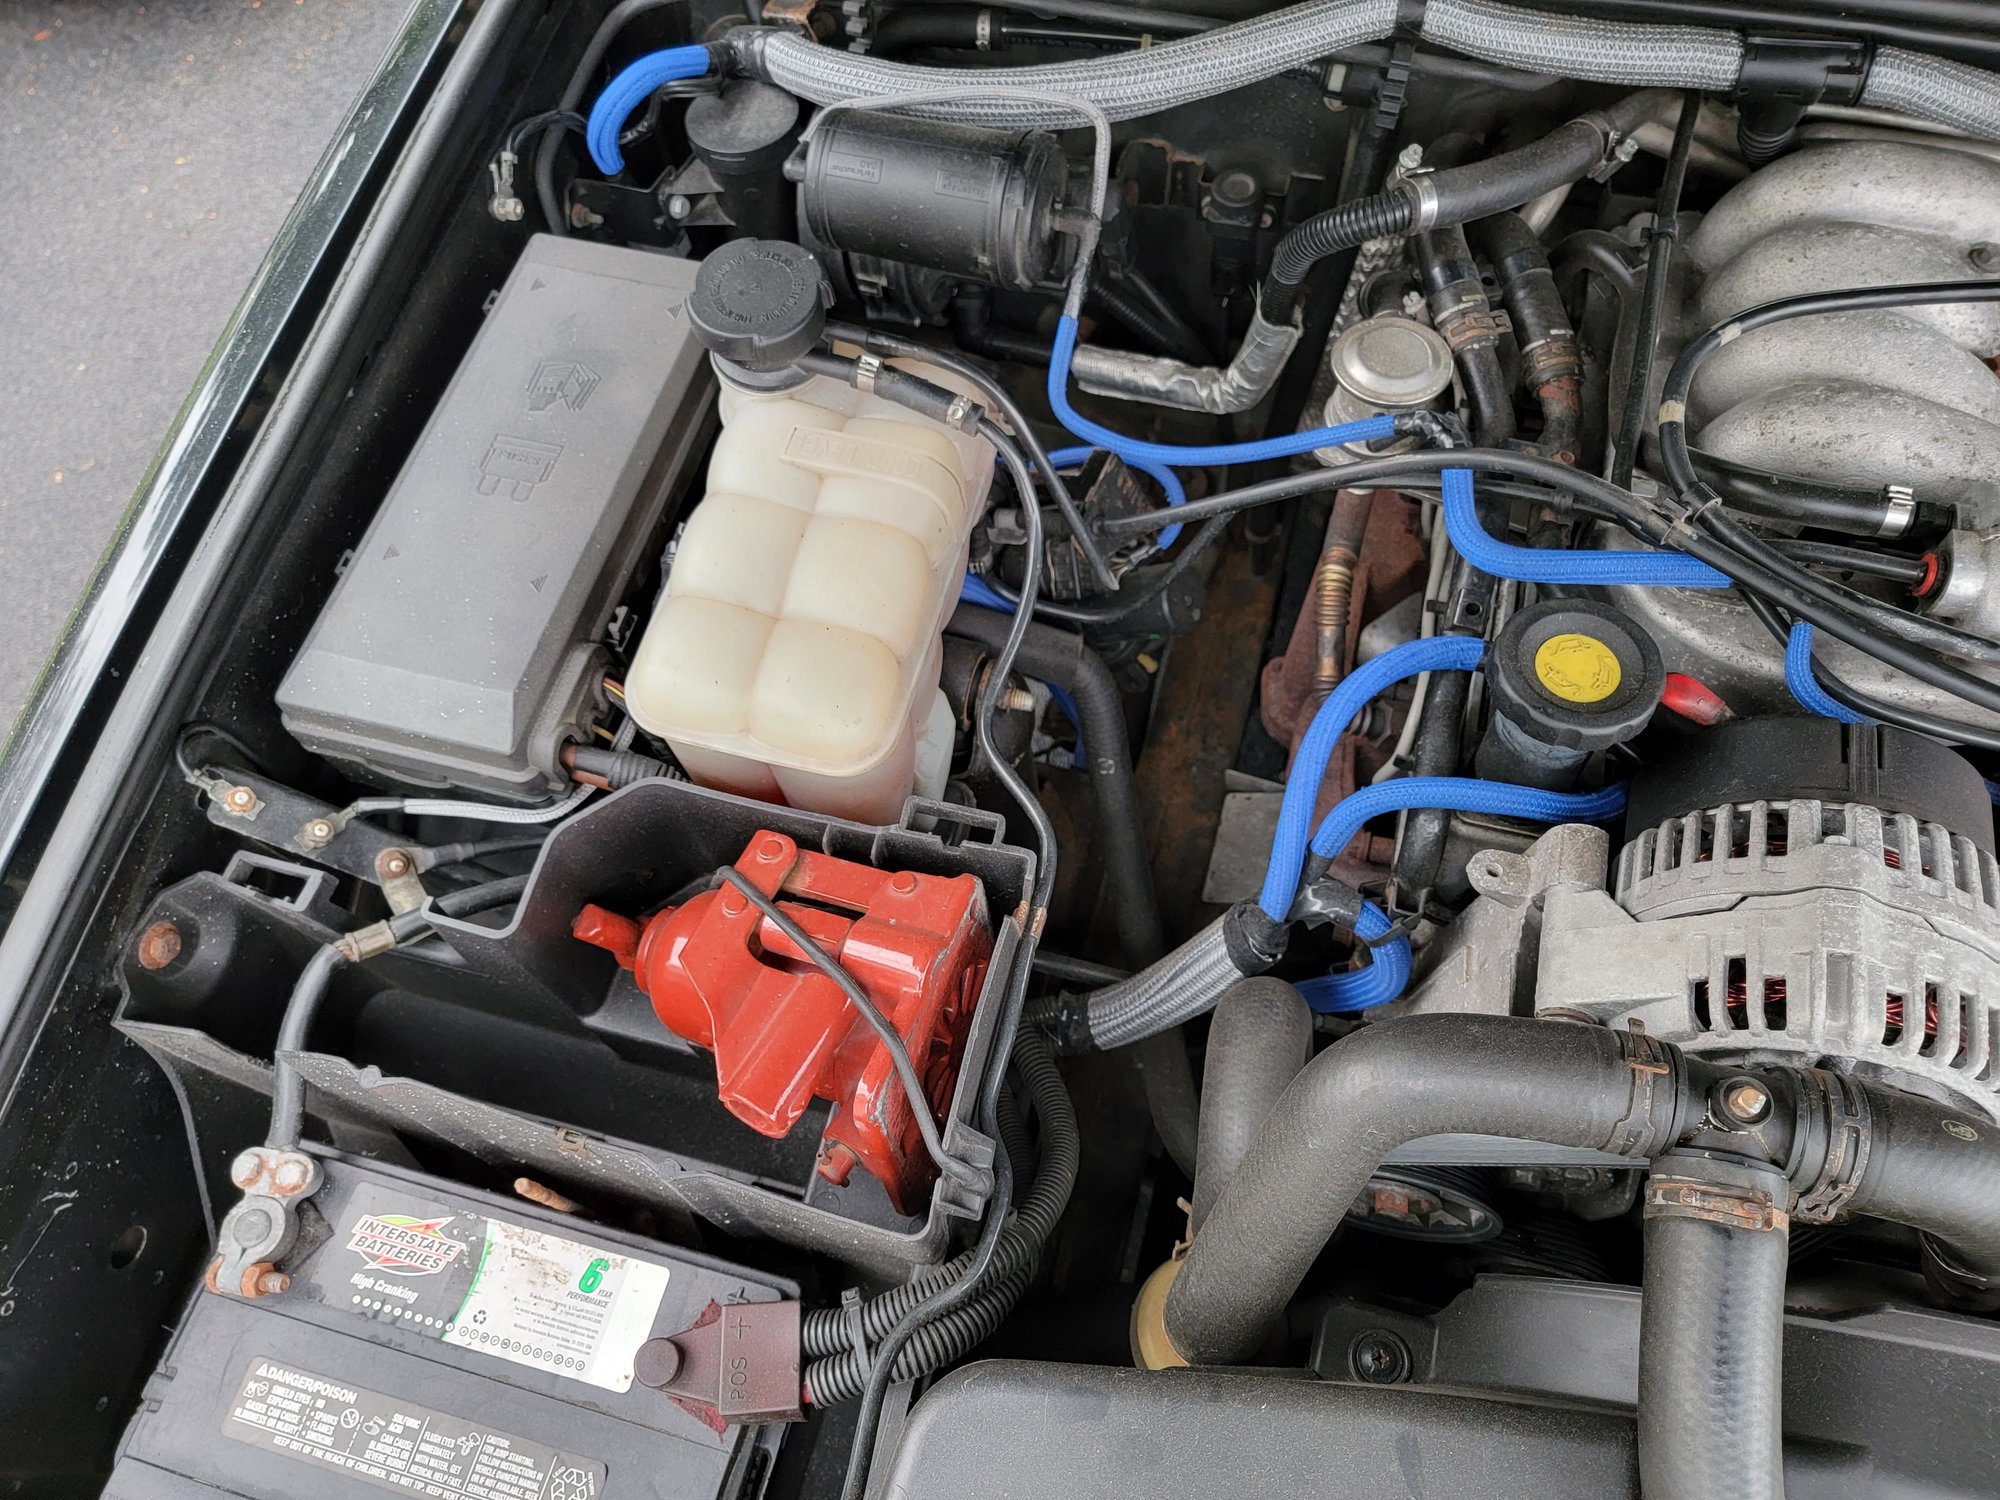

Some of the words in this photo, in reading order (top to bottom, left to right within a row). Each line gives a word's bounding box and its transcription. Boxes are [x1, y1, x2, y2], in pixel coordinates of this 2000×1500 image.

[359, 1220, 457, 1257] INTERSTATE
[354, 1236, 443, 1269] BATTERIES
[350, 1272, 376, 1289] High
[372, 1280, 419, 1304] Cranking
[578, 1258, 611, 1294] 6
[598, 1289, 614, 1299] YEAR
[566, 1290, 610, 1309] PERFORMANCE
[267, 1366, 358, 1404] DANGER/POISON
[730, 1356, 748, 1400] POS
[266, 1395, 302, 1413] EXPLOSIVE
[271, 1385, 294, 1400] SHIELD
[294, 1391, 312, 1405] EYES
[234, 1407, 268, 1425] BLINDNESS
[266, 1416, 277, 1428] OR
[245, 1399, 267, 1414] GASES
[267, 1405, 281, 1418] CAN
[280, 1409, 301, 1424] CAUSE
[314, 1411, 339, 1426] SPARKS
[310, 1420, 335, 1435] FLAMES
[380, 1433, 394, 1445] CAN
[393, 1438, 415, 1451] CAUSE
[423, 1431, 442, 1444] FLUSH
[440, 1437, 456, 1448] EYES
[364, 1449, 387, 1464] SEVERE
[368, 1439, 401, 1457] BLINDNESS
[400, 1450, 411, 1461] OR
[482, 1443, 495, 1454] FOR
[492, 1447, 510, 1459] JUMP
[273, 1436, 291, 1447] KEEP
[289, 1440, 304, 1451] OUT
[302, 1444, 313, 1454] OF
[312, 1447, 325, 1459] THE
[324, 1452, 347, 1466] REACH
[345, 1458, 356, 1468] OF
[389, 1472, 401, 1483] DO
[399, 1477, 414, 1487] NOT
[425, 1485, 444, 1497] KEEP
[409, 1463, 433, 1479] MEDICAL
[432, 1471, 448, 1484] HELP
[414, 1453, 430, 1465] WITH
[449, 1464, 462, 1475] GET
[474, 1463, 497, 1478] VEHICLE
[478, 1453, 501, 1468] FOLLOW
[499, 1459, 537, 1479] INSTRUCTIONS
[552, 1465, 566, 1479] LEAD
[466, 1483, 489, 1497] SERVICE
[470, 1473, 481, 1484] OR
[484, 1478, 497, 1489] NOT
